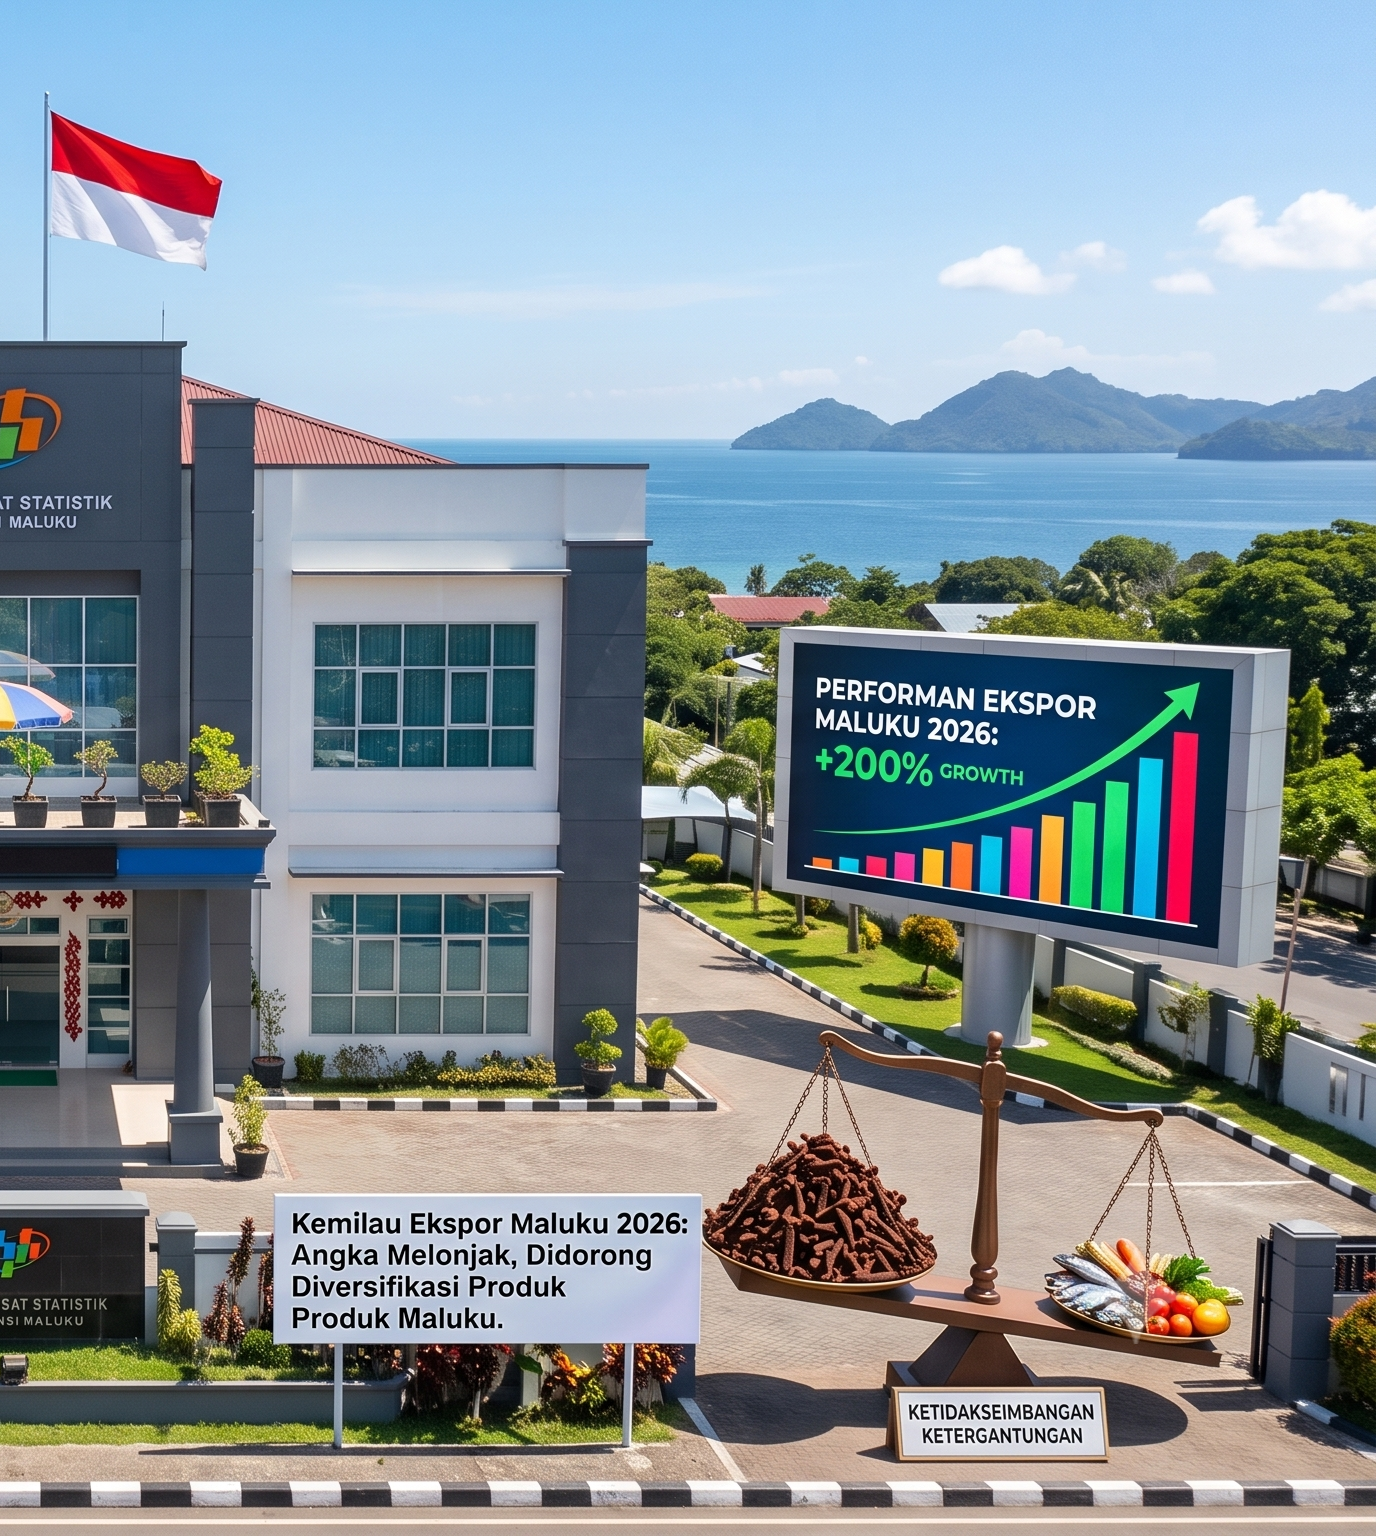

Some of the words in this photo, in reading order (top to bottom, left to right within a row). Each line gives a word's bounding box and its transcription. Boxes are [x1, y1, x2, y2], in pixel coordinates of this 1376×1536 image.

[19, 495, 113, 510] STATISTIK
[9, 515, 77, 529] MALUKU
[815, 677, 975, 711] PERFORMAN
[983, 688, 1097, 720] EKSPOR
[815, 707, 920, 738] MALUKU
[927, 717, 999, 746] 2026:
[815, 744, 934, 787] +200%
[939, 763, 1024, 786] GROWTH
[291, 1211, 401, 1235] Kemilau
[410, 1212, 503, 1240] Ekspor
[511, 1212, 608, 1235] Maluku
[617, 1212, 688, 1235] 2026:
[291, 1243, 379, 1271] Angka
[388, 1243, 517, 1271] Melonjak,
[527, 1243, 652, 1271] Didorong
[292, 1274, 459, 1298] Diversifikasi
[469, 1275, 566, 1298] Produk
[33, 1298, 108, 1311] STATISTIK
[24, 1316, 84, 1326] MALUKU
[292, 1307, 390, 1329] Produk
[399, 1307, 503, 1329] Maluku.
[908, 1403, 1095, 1421] KETIDAKSEIMBANGAN
[922, 1427, 1083, 1444] KETERGANTUNGAN
